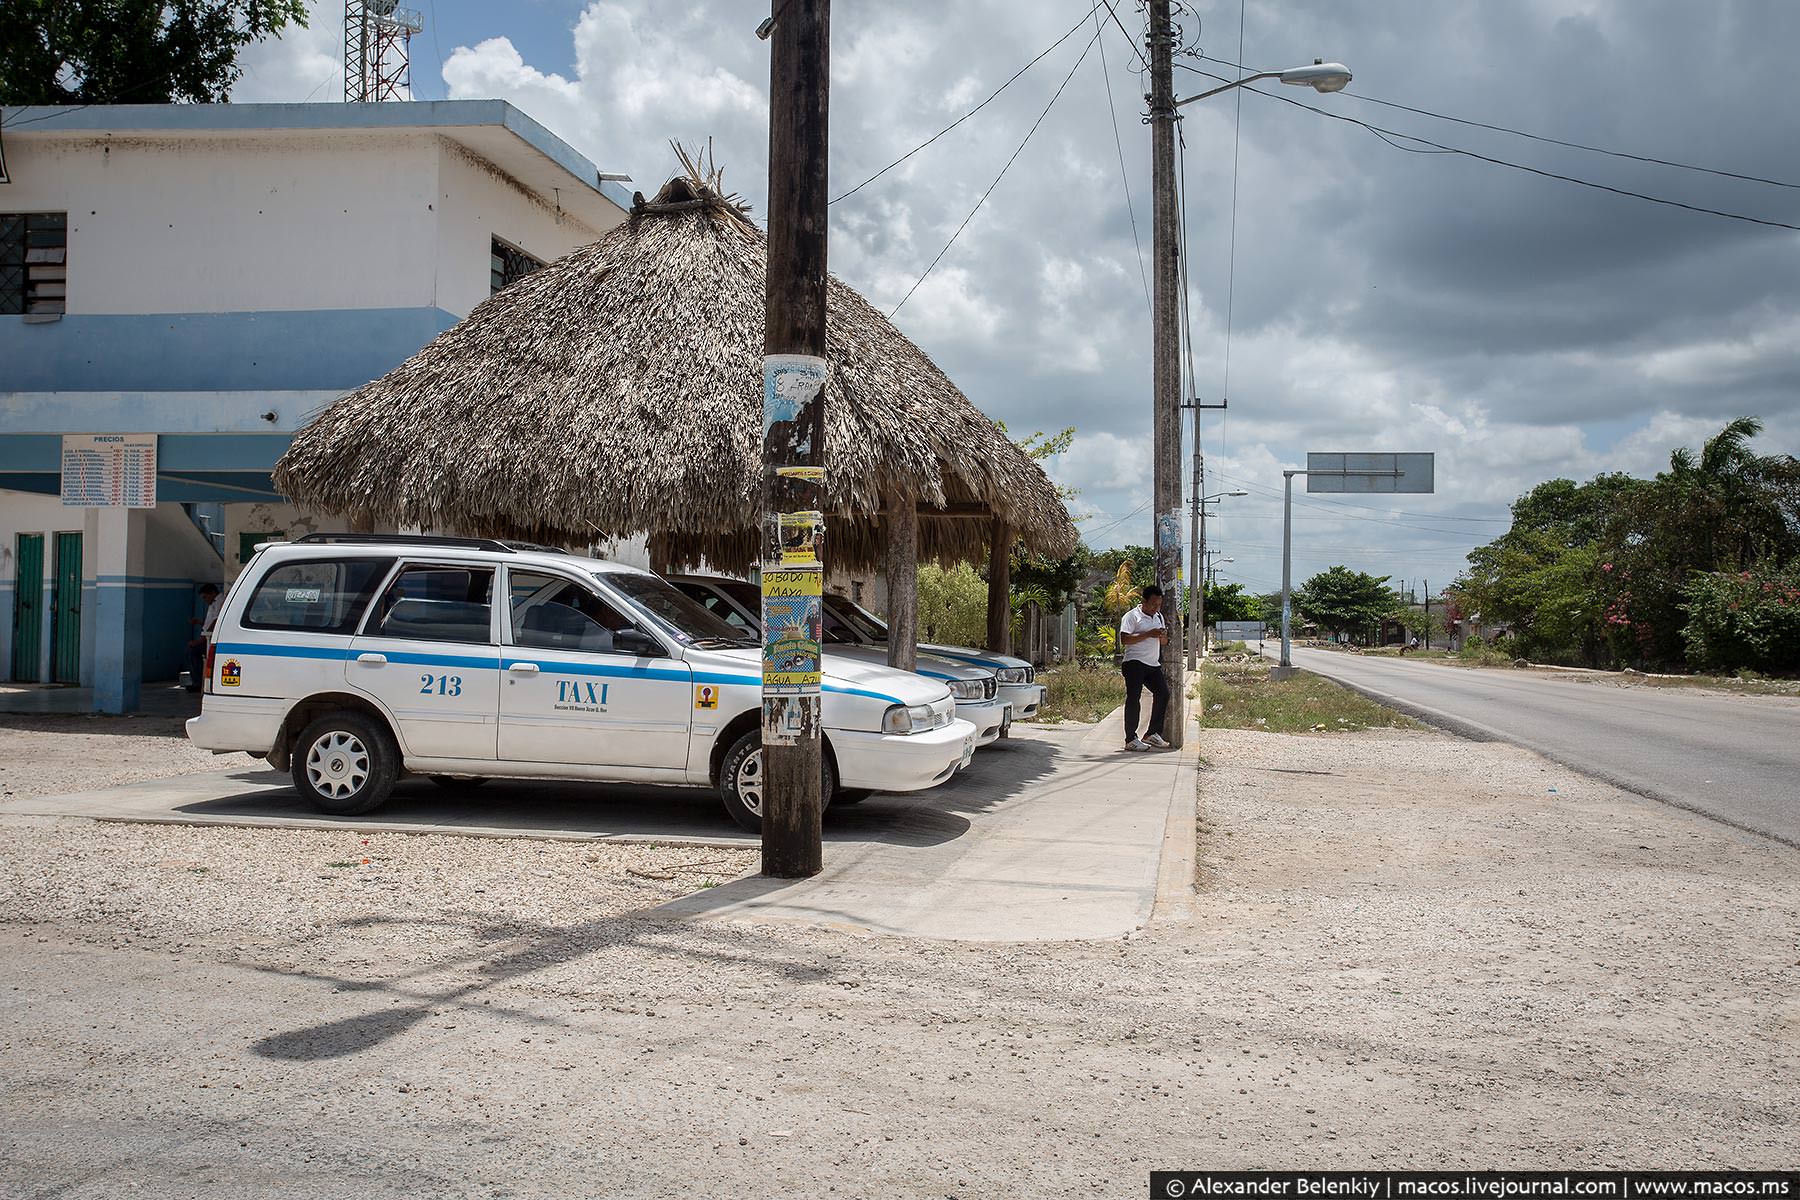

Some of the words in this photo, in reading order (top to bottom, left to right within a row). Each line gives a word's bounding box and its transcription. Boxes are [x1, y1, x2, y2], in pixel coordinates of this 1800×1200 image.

[769, 586, 802, 597] MAYO
[419, 673, 462, 697] 213
[765, 674, 791, 685] AGUA
[555, 680, 609, 705] TAXI
[728, 743, 753, 791] AVANTE
